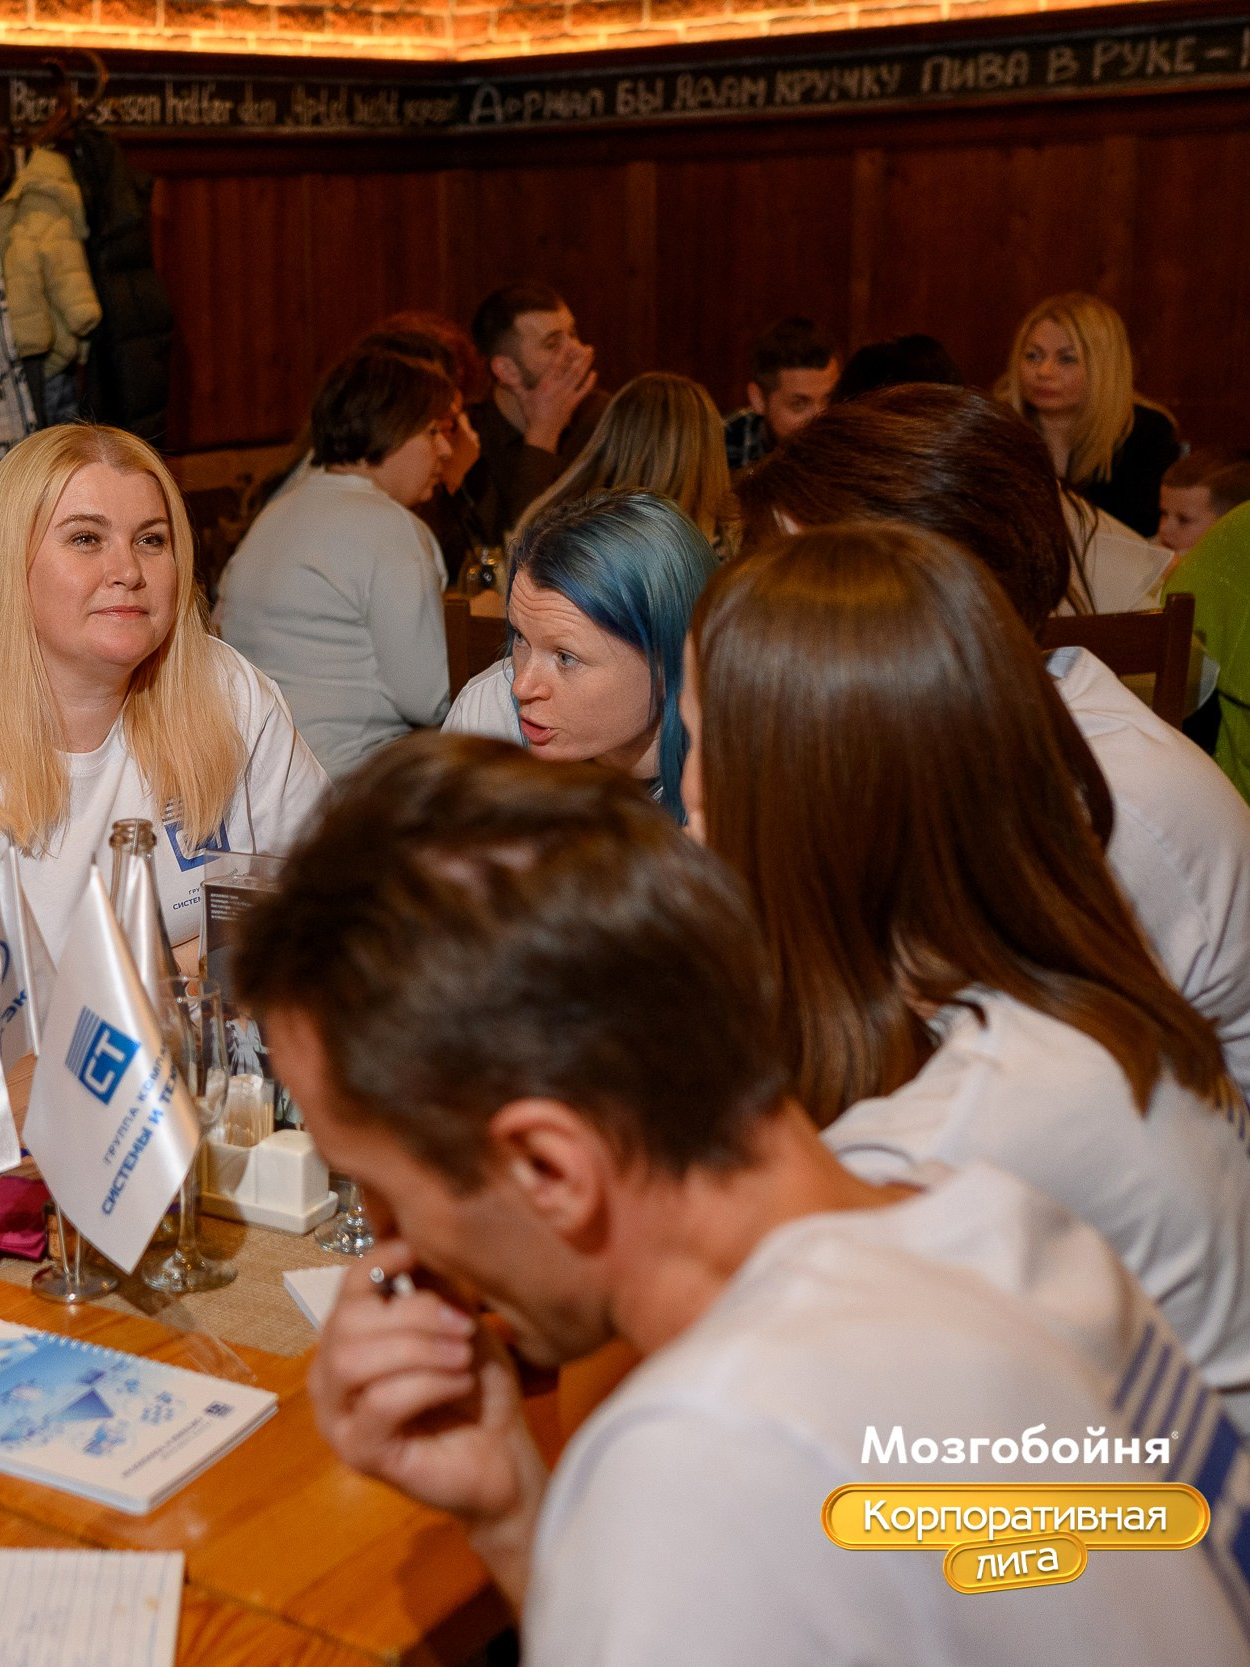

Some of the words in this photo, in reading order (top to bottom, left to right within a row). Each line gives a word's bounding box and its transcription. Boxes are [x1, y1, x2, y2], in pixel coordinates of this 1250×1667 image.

[920, 50, 1029, 93] ПИВА
[1046, 45, 1080, 84] В
[1092, 35, 1198, 82] РУКЕ
[102, 1126, 153, 1215] СИСТЕМЫ
[148, 1107, 165, 1125] И
[103, 1107, 140, 1165] ГРУППА
